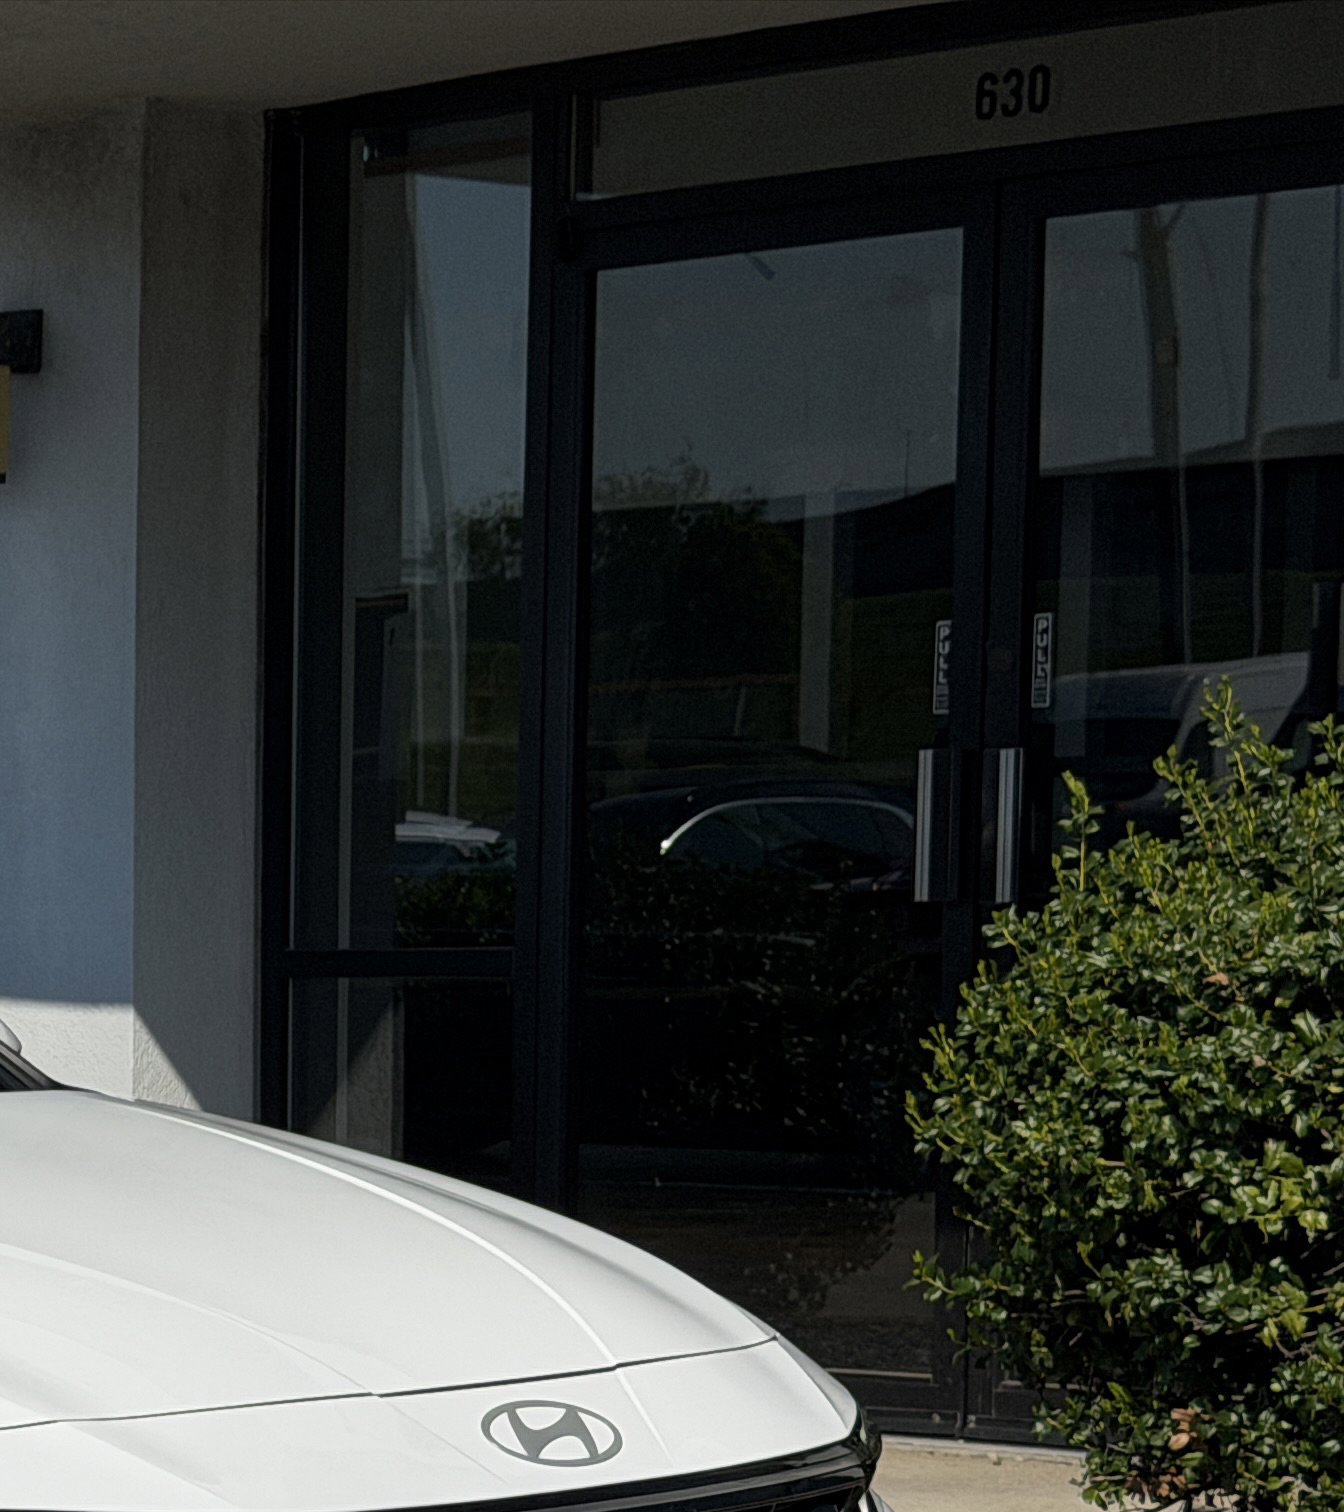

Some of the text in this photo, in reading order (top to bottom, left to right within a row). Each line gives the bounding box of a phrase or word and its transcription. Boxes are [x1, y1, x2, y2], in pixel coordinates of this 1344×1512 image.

[975, 64, 1051, 121] 630
[938, 626, 952, 684] PULL
[1037, 618, 1048, 678] PULL
